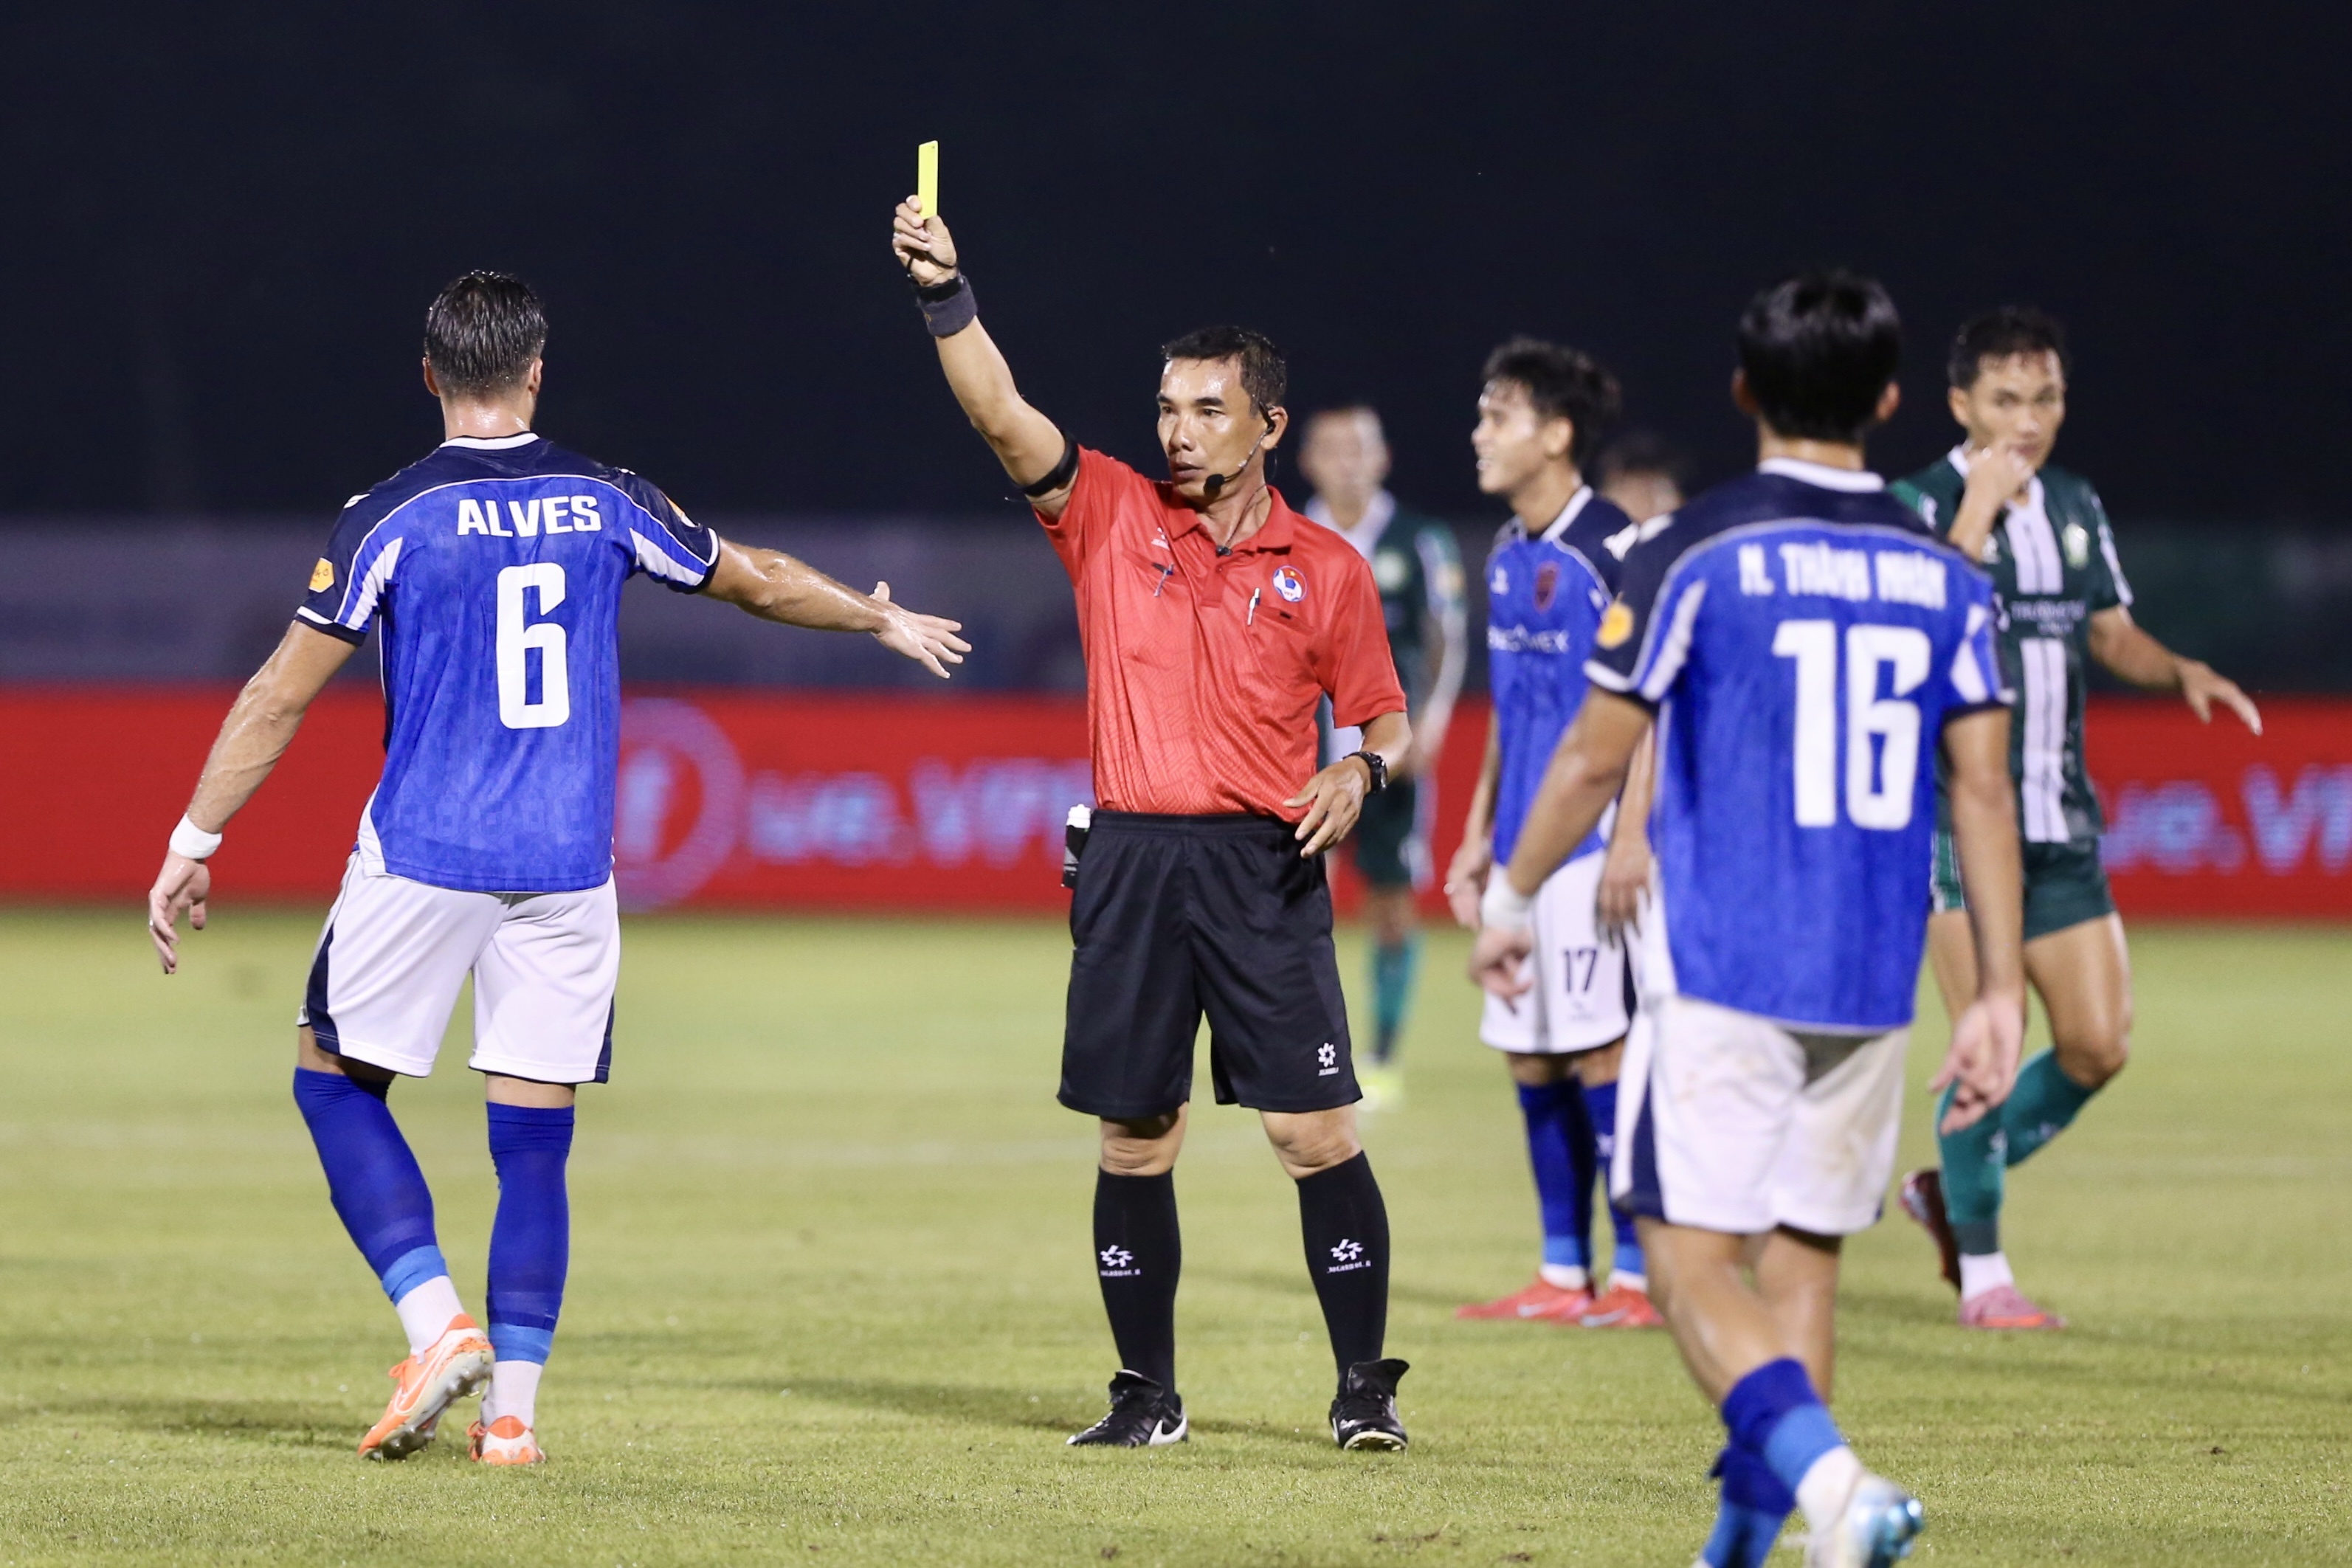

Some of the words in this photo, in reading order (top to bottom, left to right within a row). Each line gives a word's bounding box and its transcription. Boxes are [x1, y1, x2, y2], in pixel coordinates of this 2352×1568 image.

[457, 495, 602, 538] ALVES
[495, 562, 570, 730] 6
[1772, 619, 1932, 830] 16
[1564, 947, 1598, 994] 17
